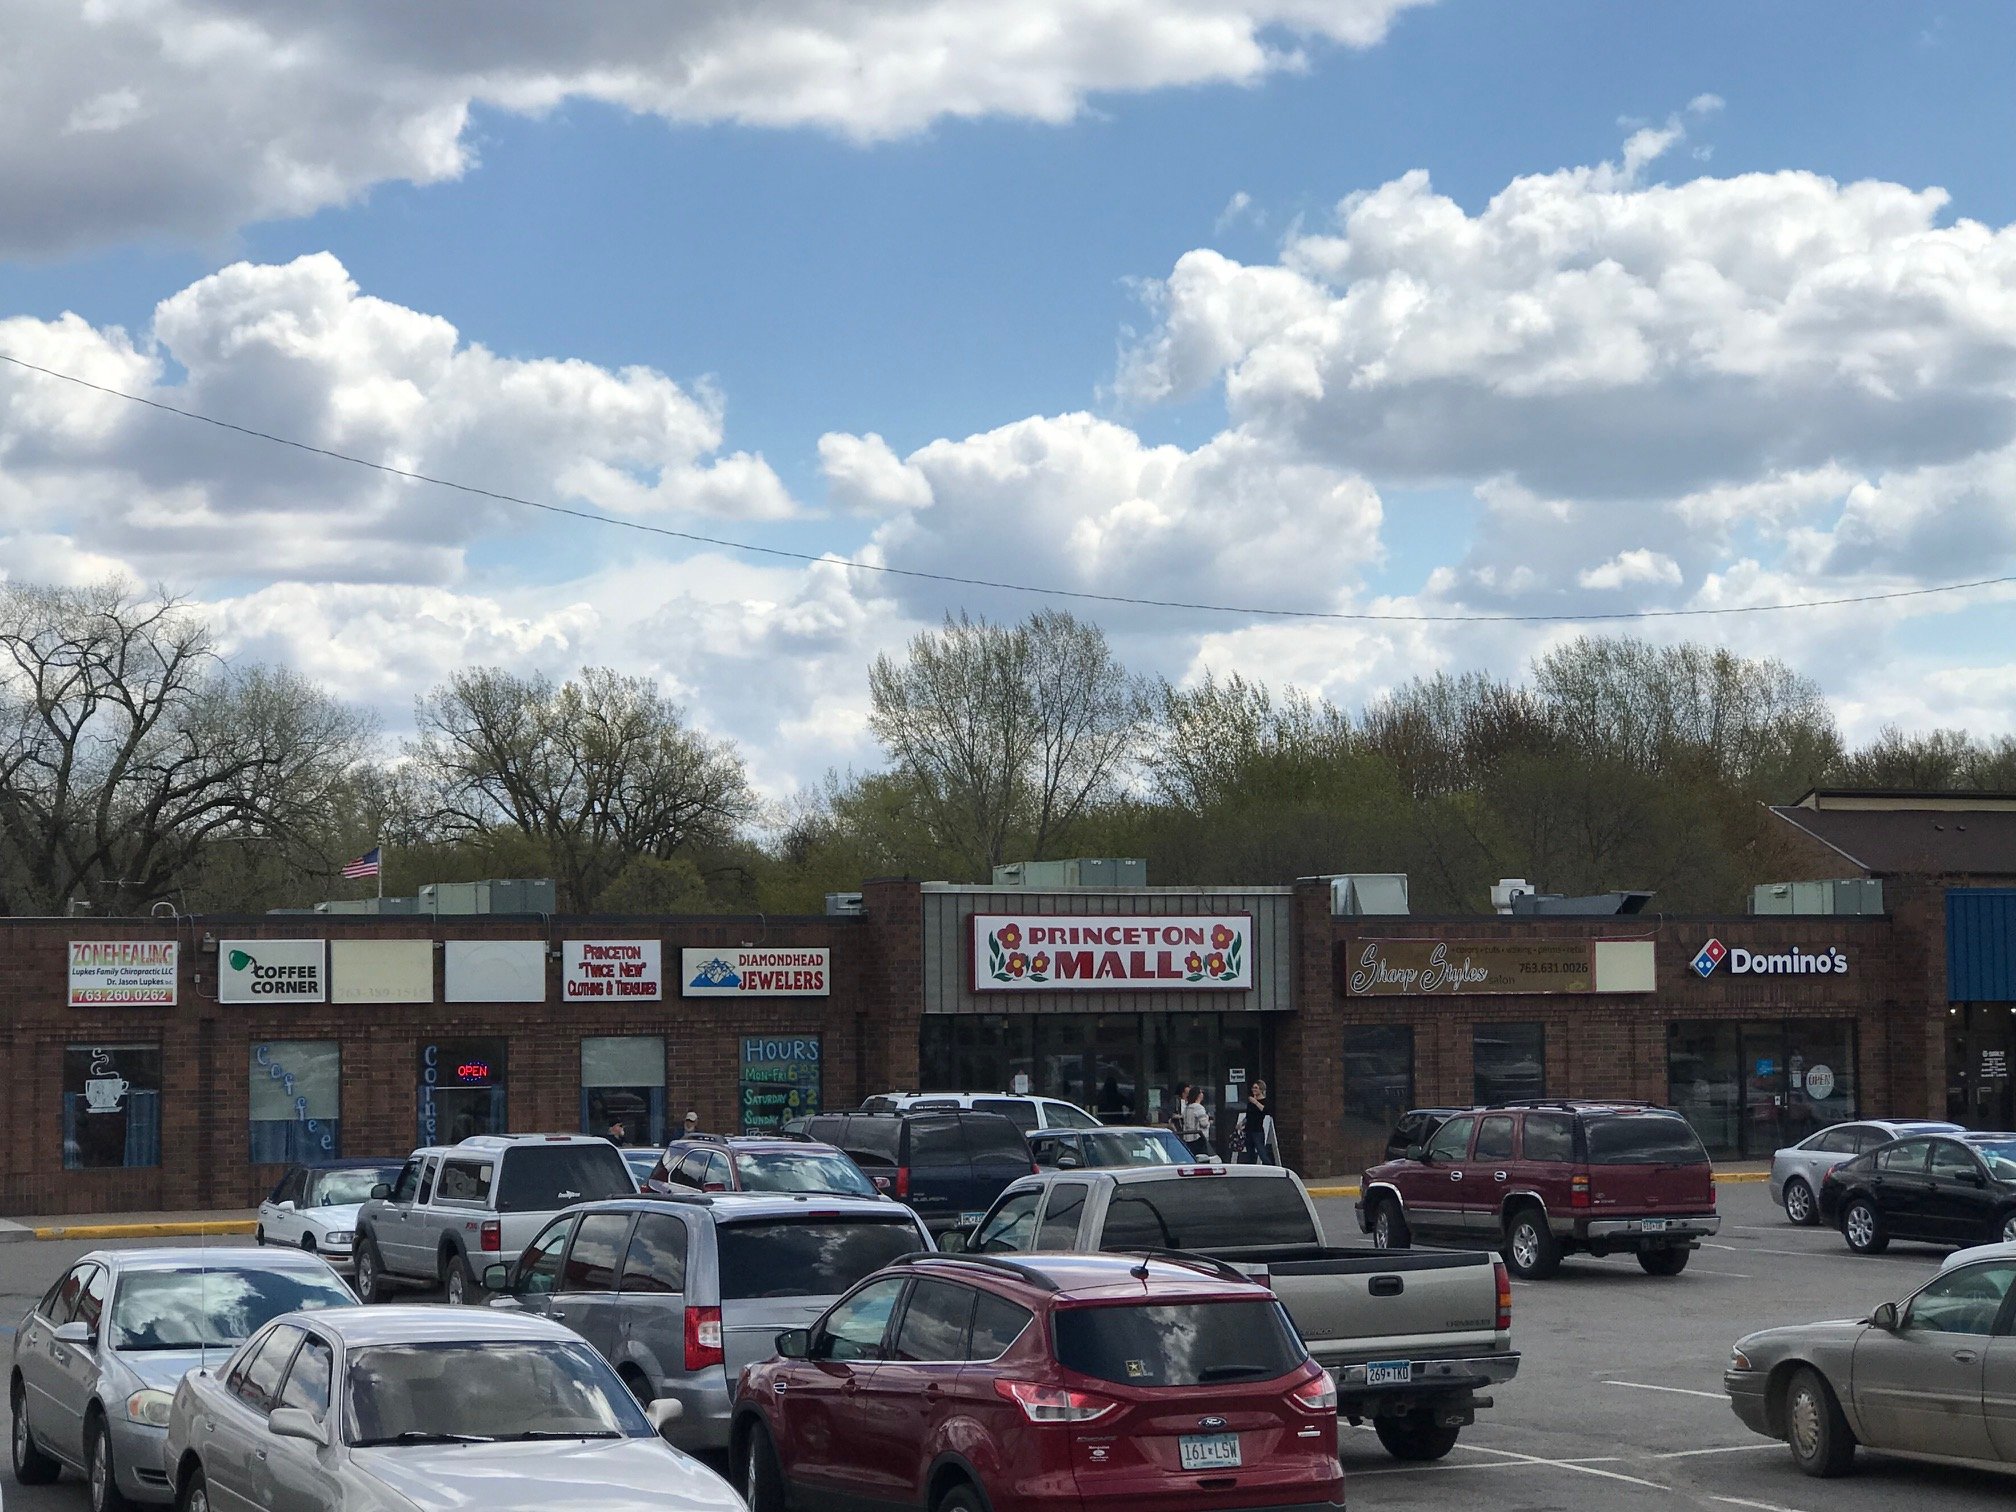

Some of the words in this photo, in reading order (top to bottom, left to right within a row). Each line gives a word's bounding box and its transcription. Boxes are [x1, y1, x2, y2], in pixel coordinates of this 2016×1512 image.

[1028, 926, 1204, 945] PRINCETON
[583, 944, 641, 960] PRINCETON
[738, 954, 824, 966] DIAMONDHEAD
[1731, 946, 1848, 974] Domino's
[72, 968, 95, 976] Lupkes
[96, 968, 119, 976] Family
[120, 968, 161, 976] Chiropractic
[254, 966, 317, 979] COFFEE
[1054, 951, 1183, 979] MALL
[1350, 943, 1418, 993] Sharp
[1420, 943, 1488, 991] Styles
[106, 978, 117, 986] Dr.
[118, 978, 138, 986] Jason
[140, 978, 164, 986] Lupkes
[251, 981, 318, 993] CORNER
[568, 980, 604, 996] CLOTHING
[606, 980, 613, 995] &
[615, 980, 657, 996] TREASURES
[738, 970, 824, 990] JEWELERS
[1489, 975, 1515, 985] salon
[78, 989, 167, 1001] 763.260.0262
[746, 1040, 819, 1061] HOURS
[457, 1065, 488, 1077] OPEN
[1808, 1073, 1832, 1086] OPEN
[257, 1046, 332, 1150] Coffee
[424, 1045, 437, 1147] Corner
[744, 1089, 786, 1105] SATURDAY
[744, 1110, 779, 1126] SUNDAY
[1369, 1368, 1386, 1382] 269
[1185, 1444, 1208, 1461] 161
[1214, 1441, 1238, 1459] LSW
